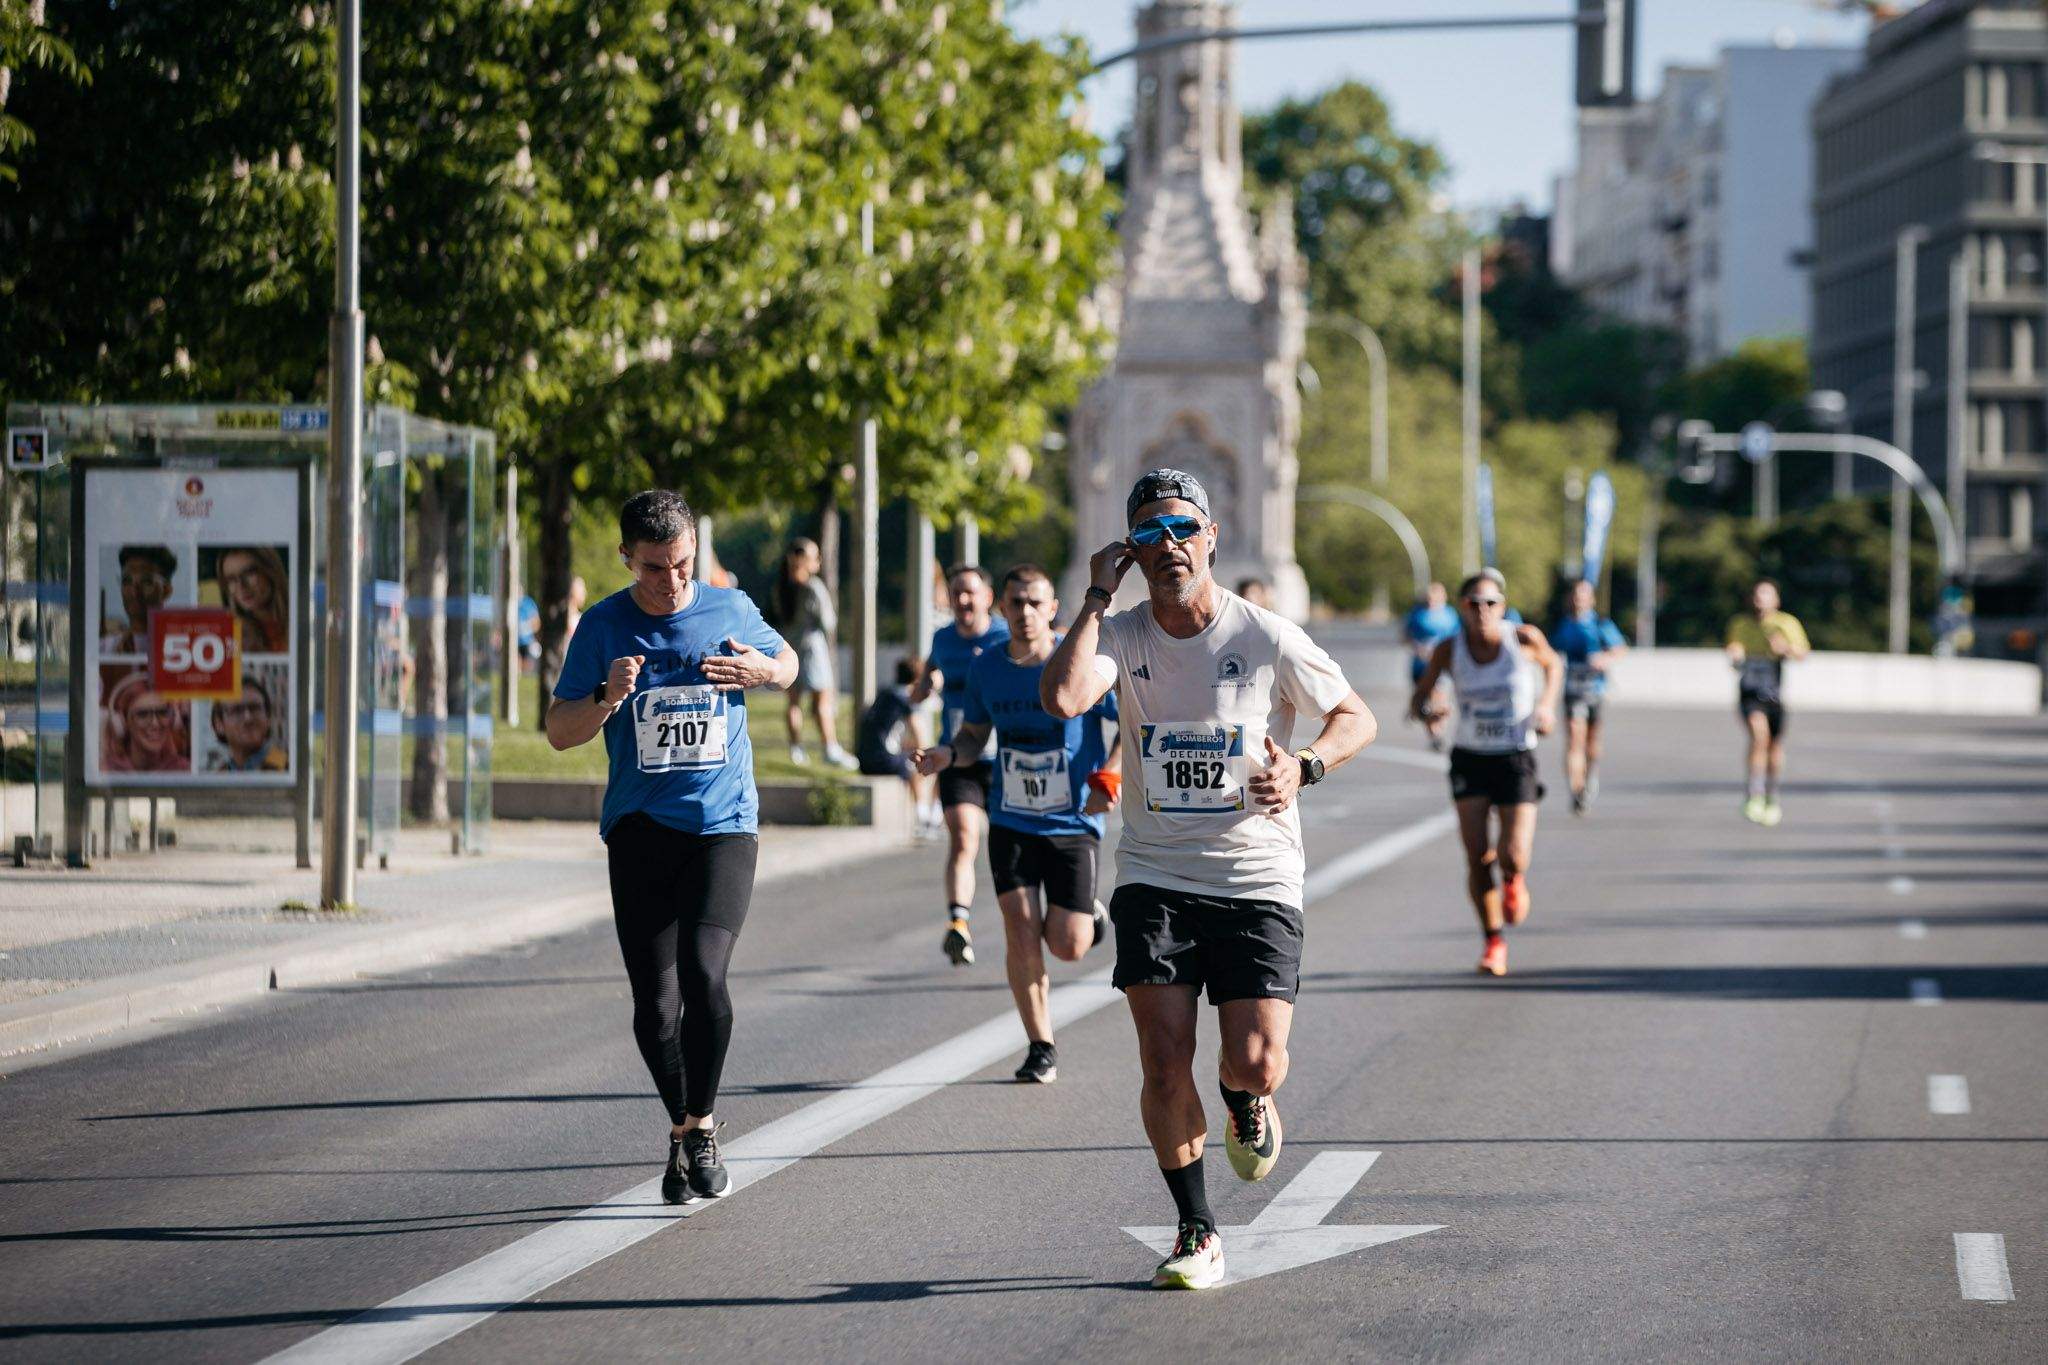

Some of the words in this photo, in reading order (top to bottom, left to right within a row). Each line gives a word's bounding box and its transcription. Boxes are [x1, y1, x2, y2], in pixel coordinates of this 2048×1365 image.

[665, 697, 710, 706] BOMBEROS
[661, 712, 709, 721] DECIMAS
[657, 721, 709, 748] 2107
[1175, 735, 1224, 744] BOMBEROS
[1170, 750, 1224, 759] DECIMAS
[1162, 760, 1226, 790] 1852
